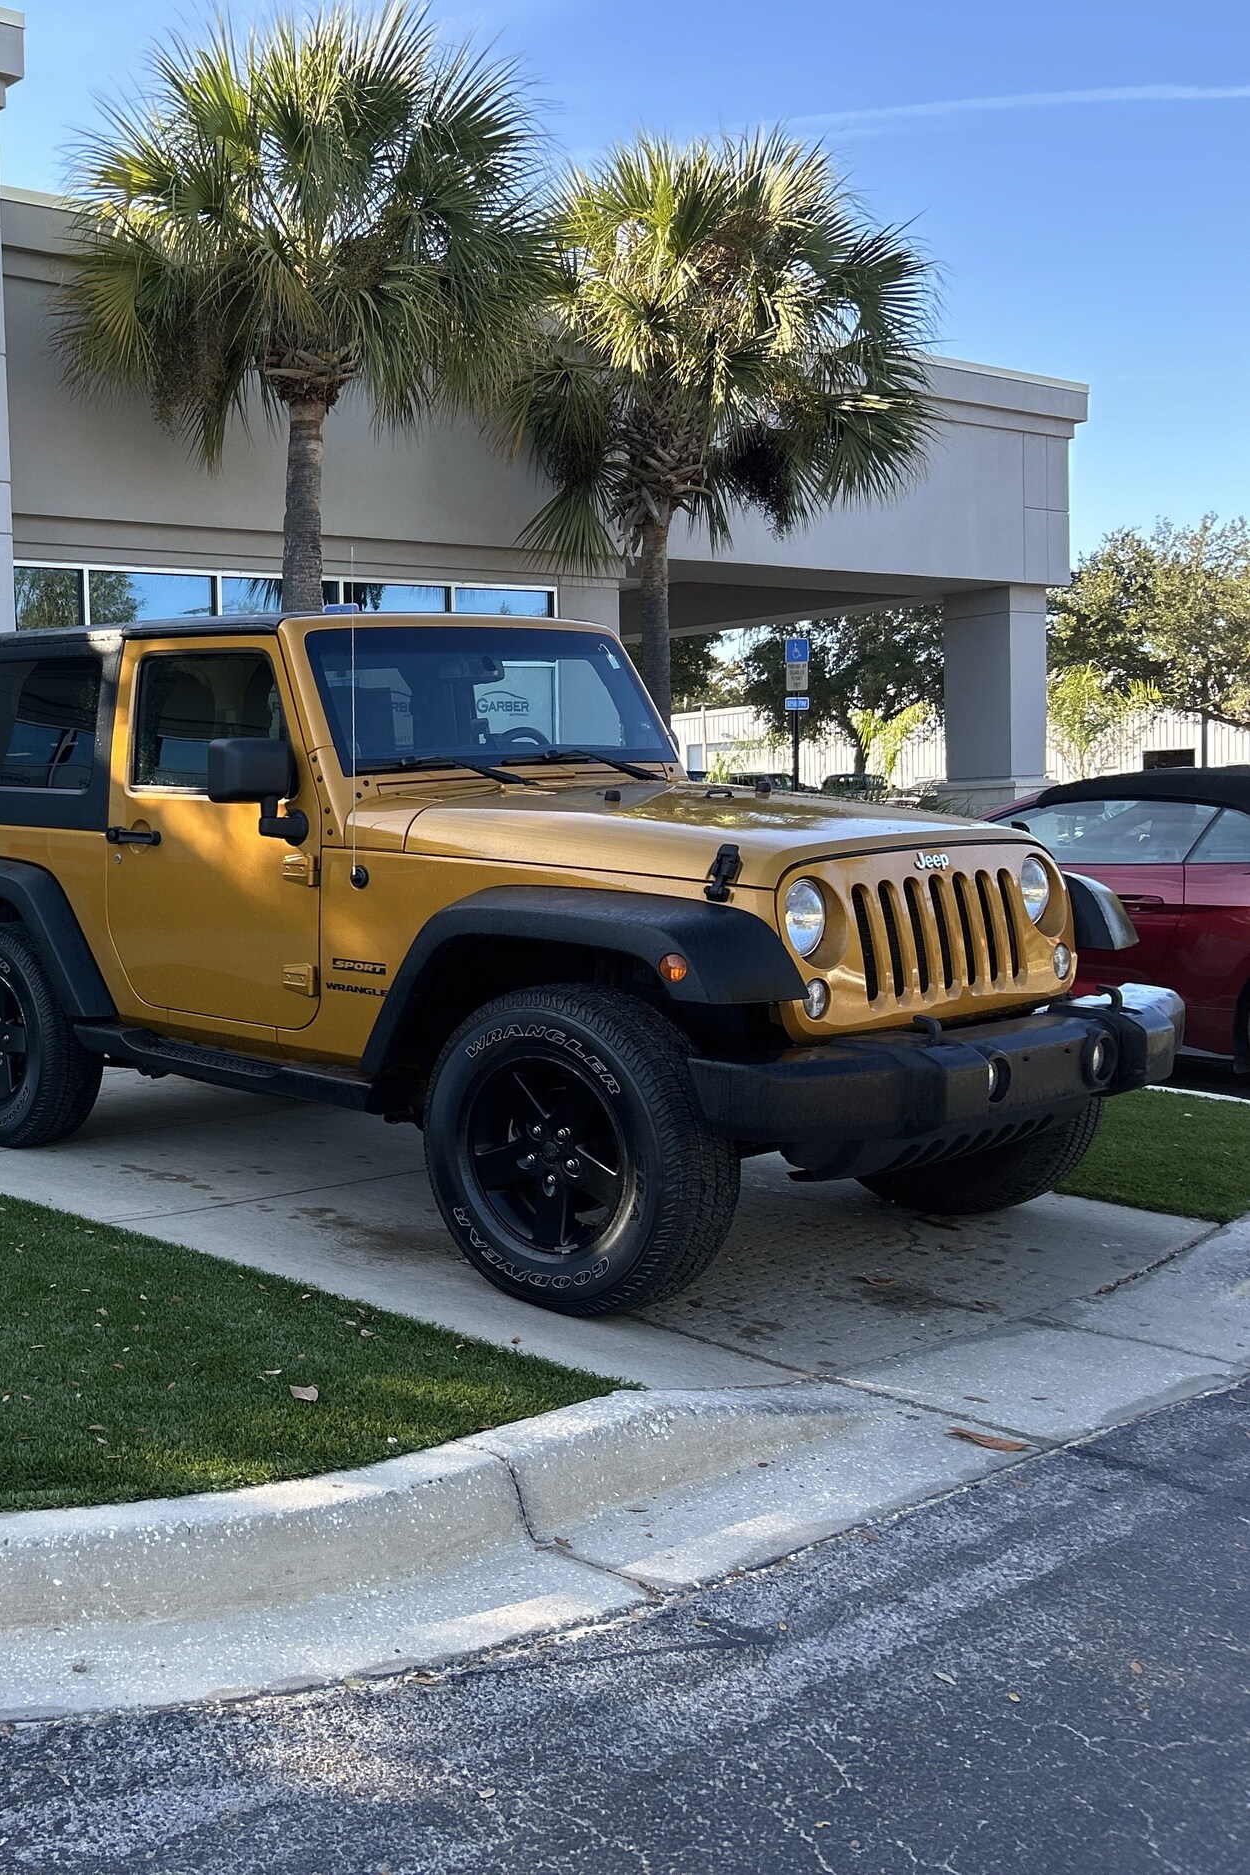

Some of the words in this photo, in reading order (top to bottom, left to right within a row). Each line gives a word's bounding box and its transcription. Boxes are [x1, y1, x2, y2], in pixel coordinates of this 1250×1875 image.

[476, 697, 530, 714] GARBER
[914, 851, 950, 871] Jeep
[334, 960, 387, 973] SPORT
[326, 982, 389, 997] WRANGLE
[465, 1024, 621, 1095] WRANGLER
[453, 1206, 610, 1289] GOODYEAR
